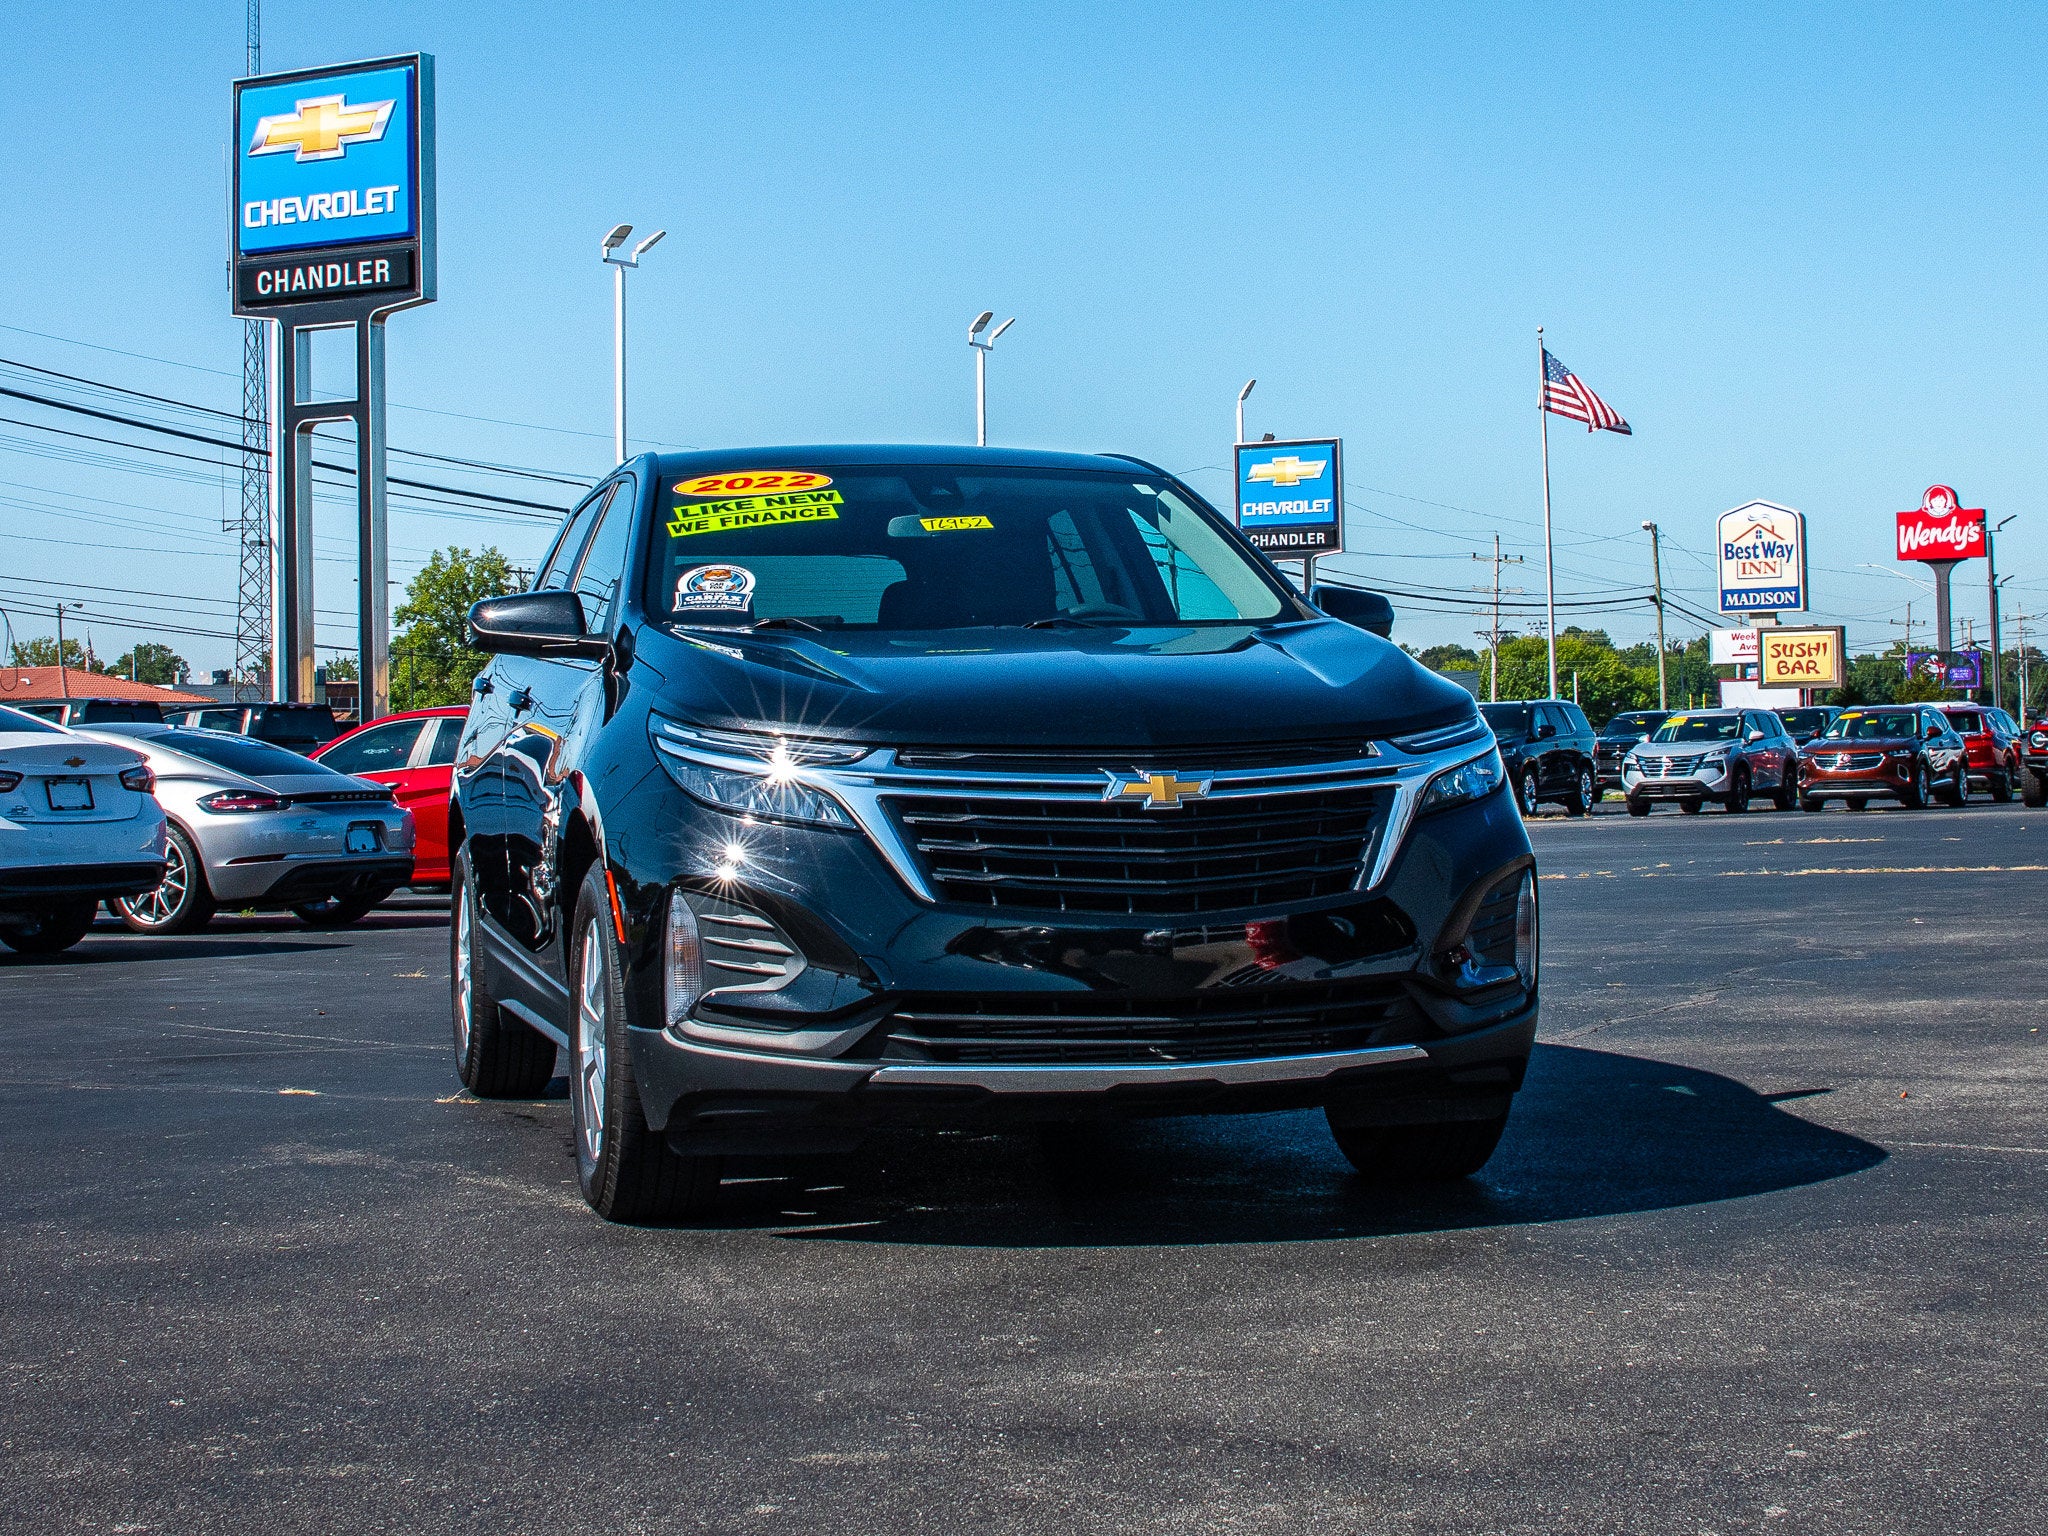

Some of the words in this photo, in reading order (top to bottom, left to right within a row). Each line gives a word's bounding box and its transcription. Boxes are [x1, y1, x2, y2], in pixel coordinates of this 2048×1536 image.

[244, 185, 399, 228] CHEVROLET
[257, 258, 390, 294] CHANDLER
[693, 475, 816, 493] 2022
[681, 499, 755, 519] LIKE
[765, 491, 835, 507] NEW
[1242, 499, 1331, 516] CHEVROLET
[671, 519, 710, 534] WE
[720, 506, 831, 528] FINANCE
[1250, 532, 1325, 547] CHANDLER
[1899, 516, 1980, 553] Wendy's
[1724, 541, 1760, 561] Best
[1761, 540, 1794, 563] Way
[1741, 560, 1778, 575] INN
[1725, 591, 1796, 607] MADISON
[1770, 642, 1828, 658] SUSHI
[1777, 660, 1820, 676] BAR
